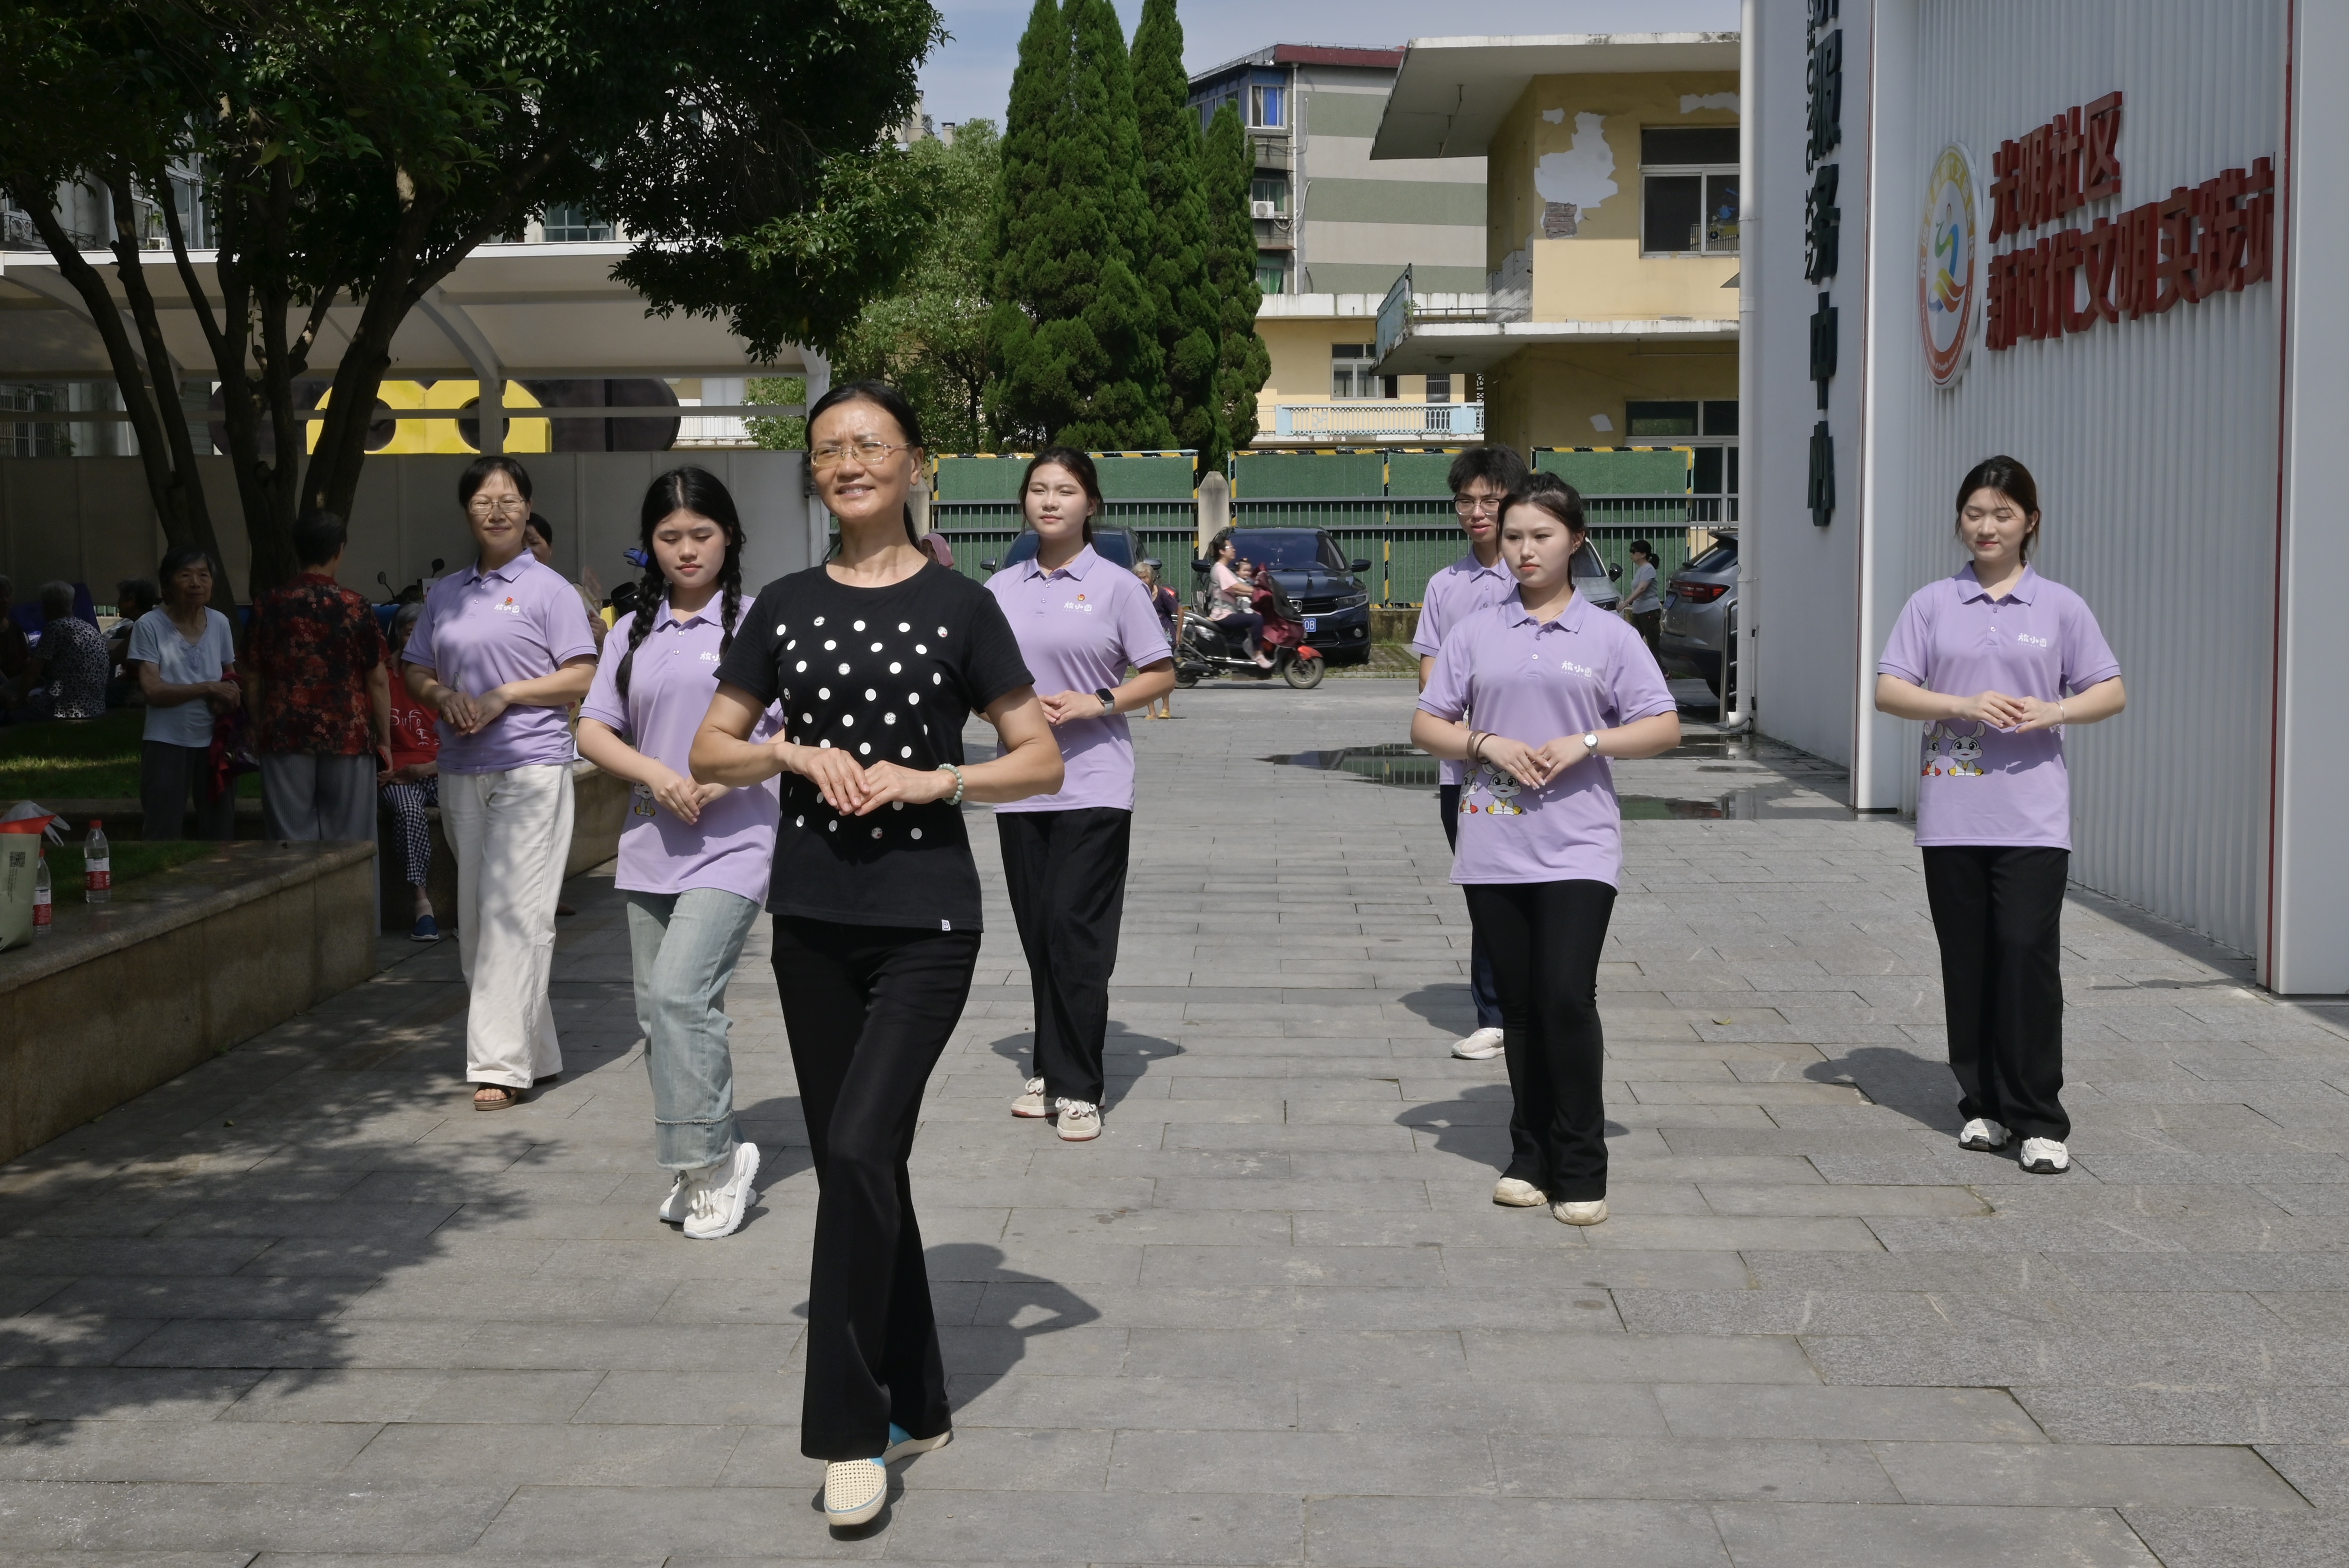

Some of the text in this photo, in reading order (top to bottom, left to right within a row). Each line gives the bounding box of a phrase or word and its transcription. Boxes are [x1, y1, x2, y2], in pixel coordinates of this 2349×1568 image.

[1989, 91, 2122, 243] 光明社区
[1808, 0, 1843, 526] 服务中心
[1063, 601, 1092, 612] 旅小团
[2018, 632, 2047, 647] 旅小团
[1561, 660, 1592, 678] 旅小团
